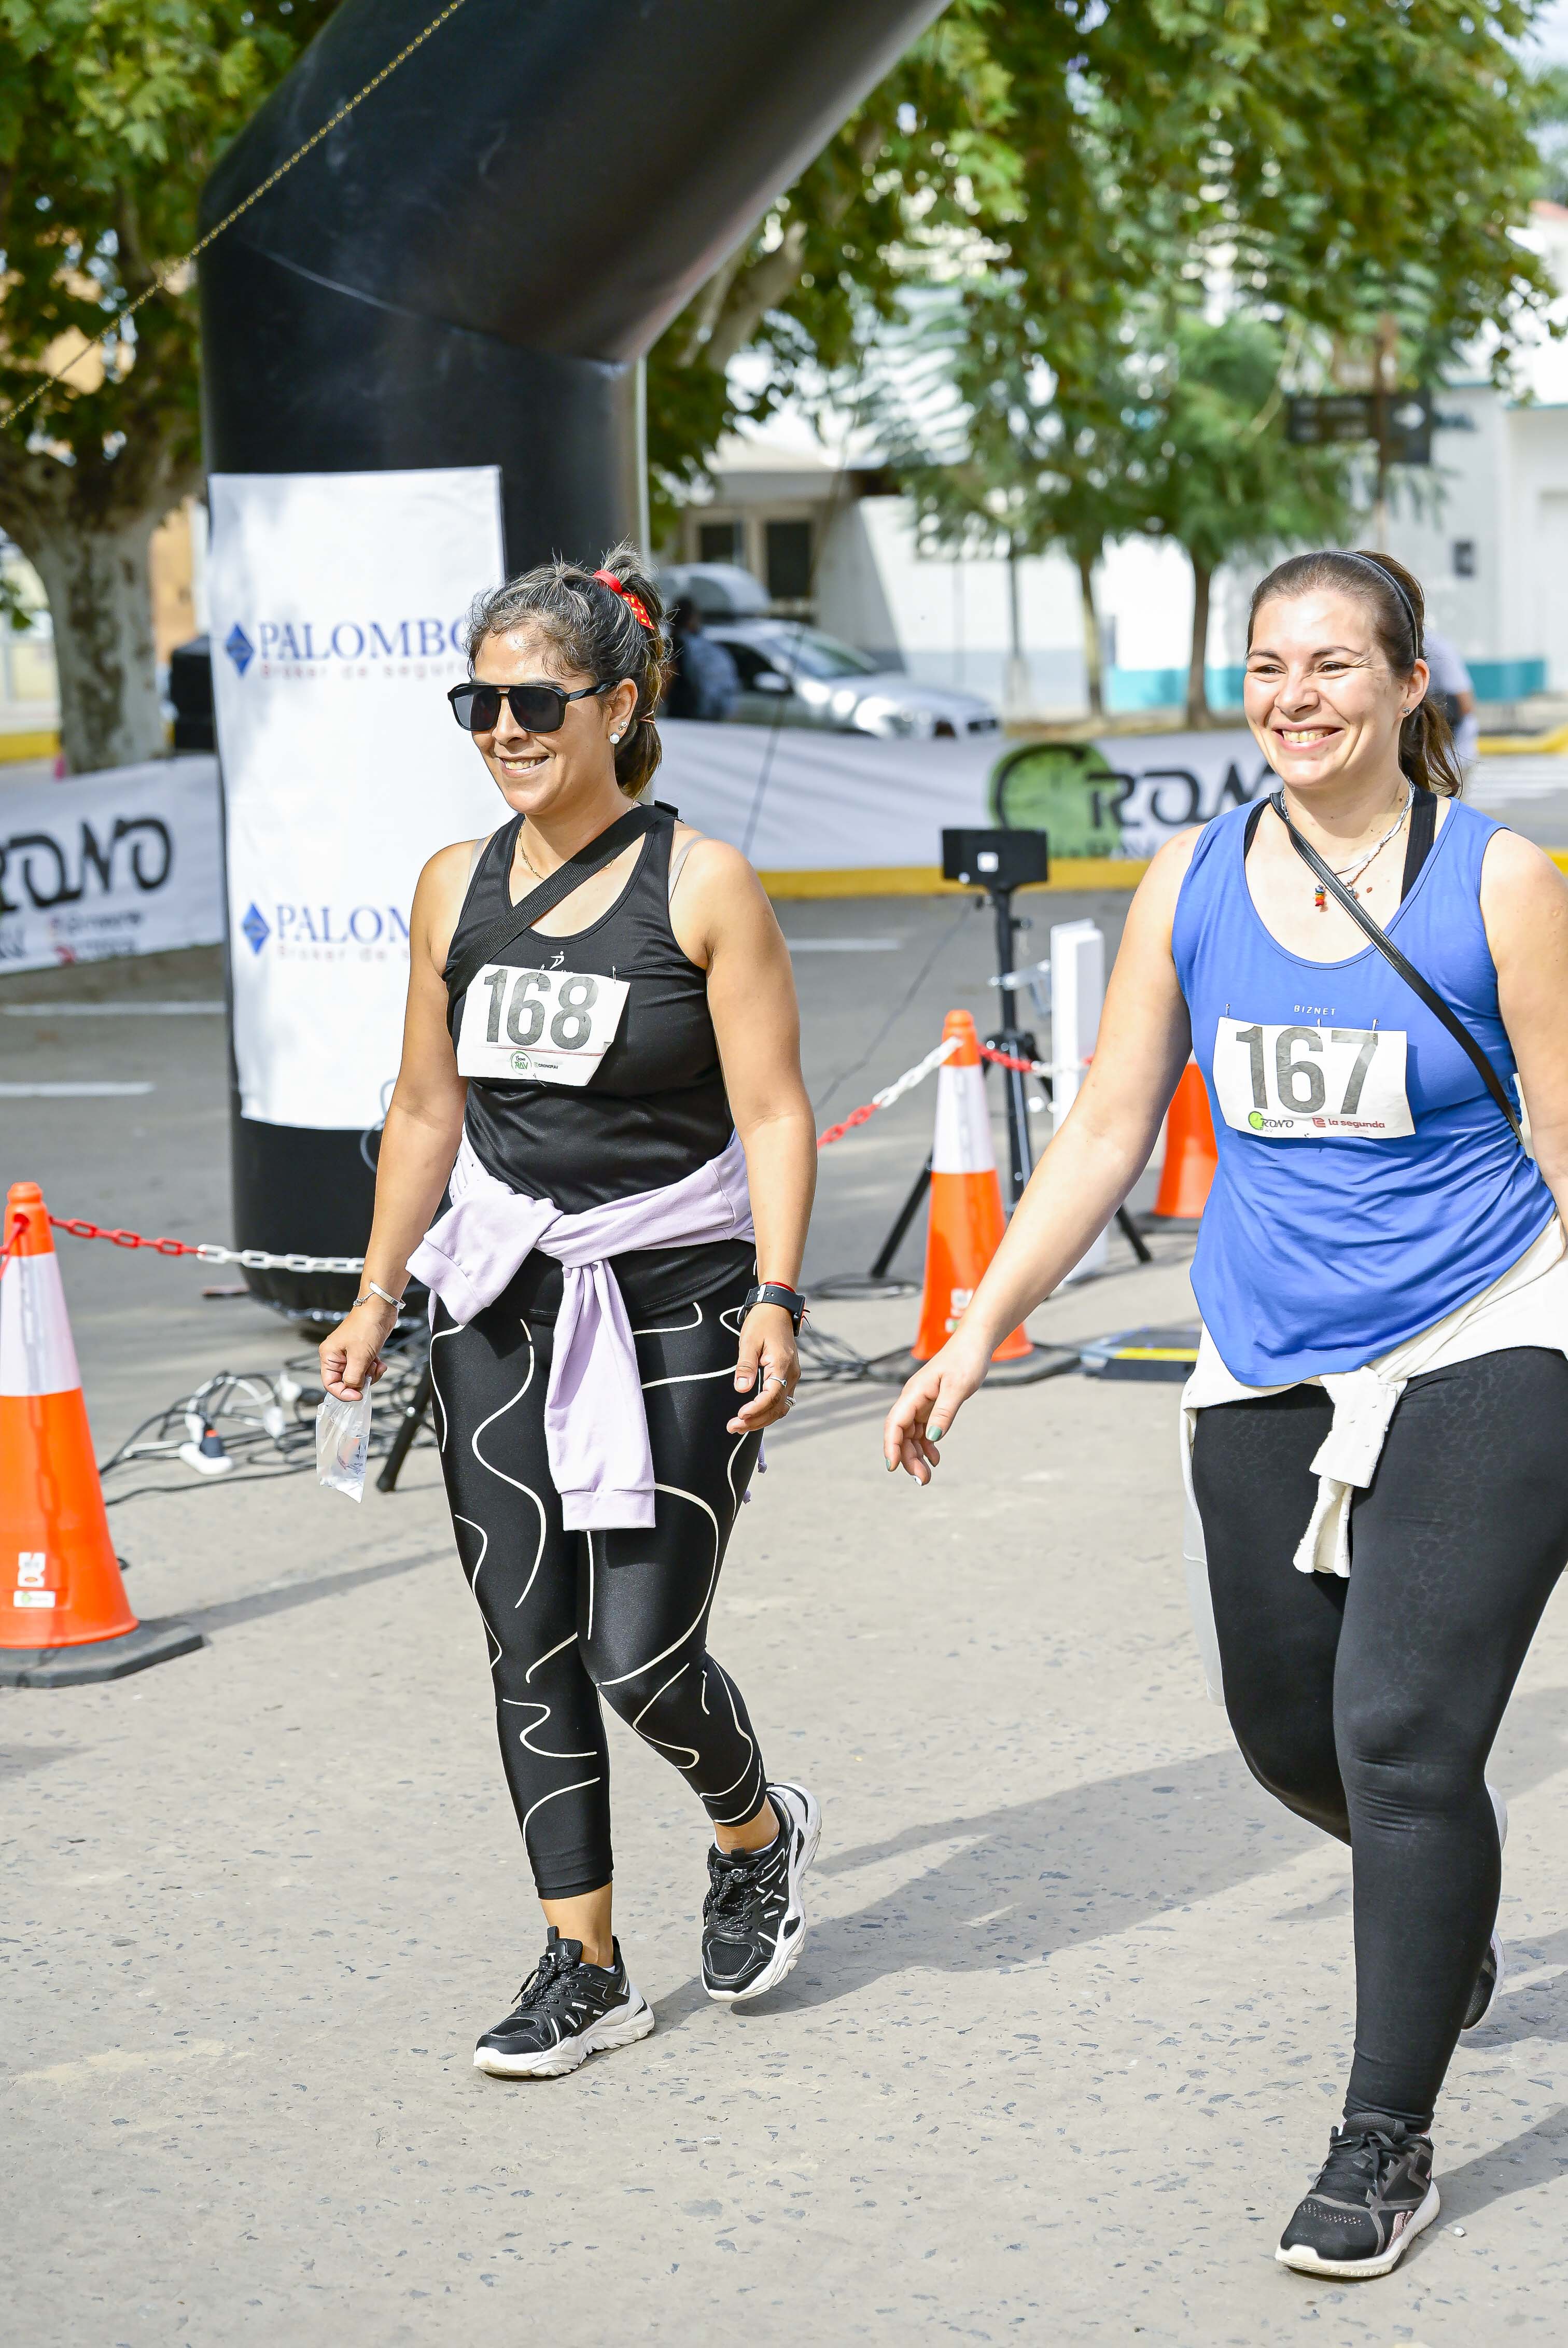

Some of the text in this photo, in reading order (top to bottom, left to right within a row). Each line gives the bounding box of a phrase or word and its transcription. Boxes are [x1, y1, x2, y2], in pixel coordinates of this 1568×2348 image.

[996, 743, 1277, 830] CRON
[484, 969, 599, 1050] 168
[1294, 1004, 1336, 1016] BIZNET
[1236, 1026, 1378, 1114] 167
